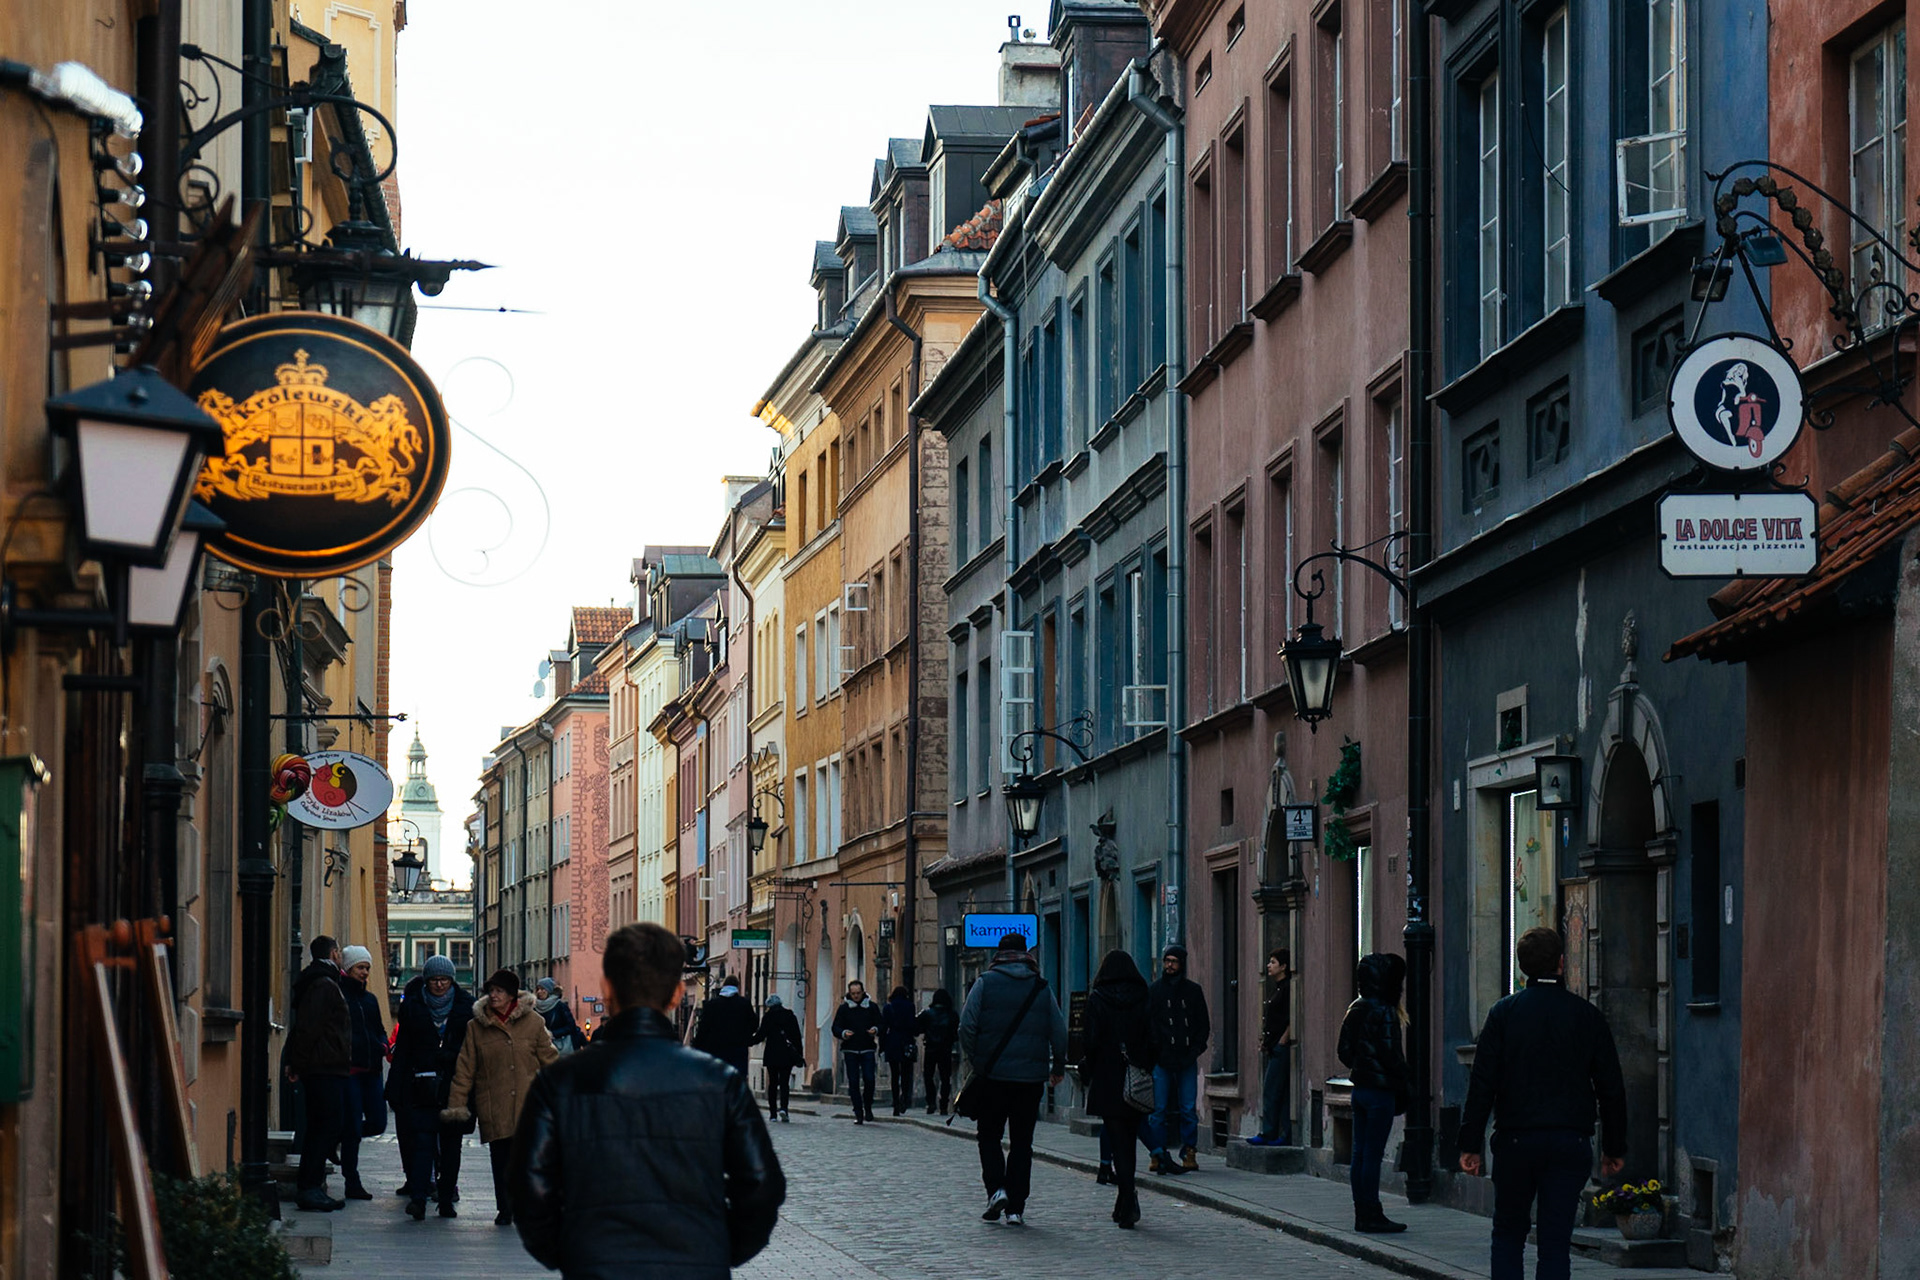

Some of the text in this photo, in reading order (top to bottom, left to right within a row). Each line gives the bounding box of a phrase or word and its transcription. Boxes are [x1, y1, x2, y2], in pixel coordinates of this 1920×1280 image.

[252, 474, 318, 491] Restaurant
[329, 479, 352, 490] Pub
[1676, 517, 1803, 541] LA DOLCE VITA
[1673, 542, 1806, 551] restauracja pizzeria
[1551, 775, 1560, 788] 4
[971, 924, 1031, 936] karmnik
